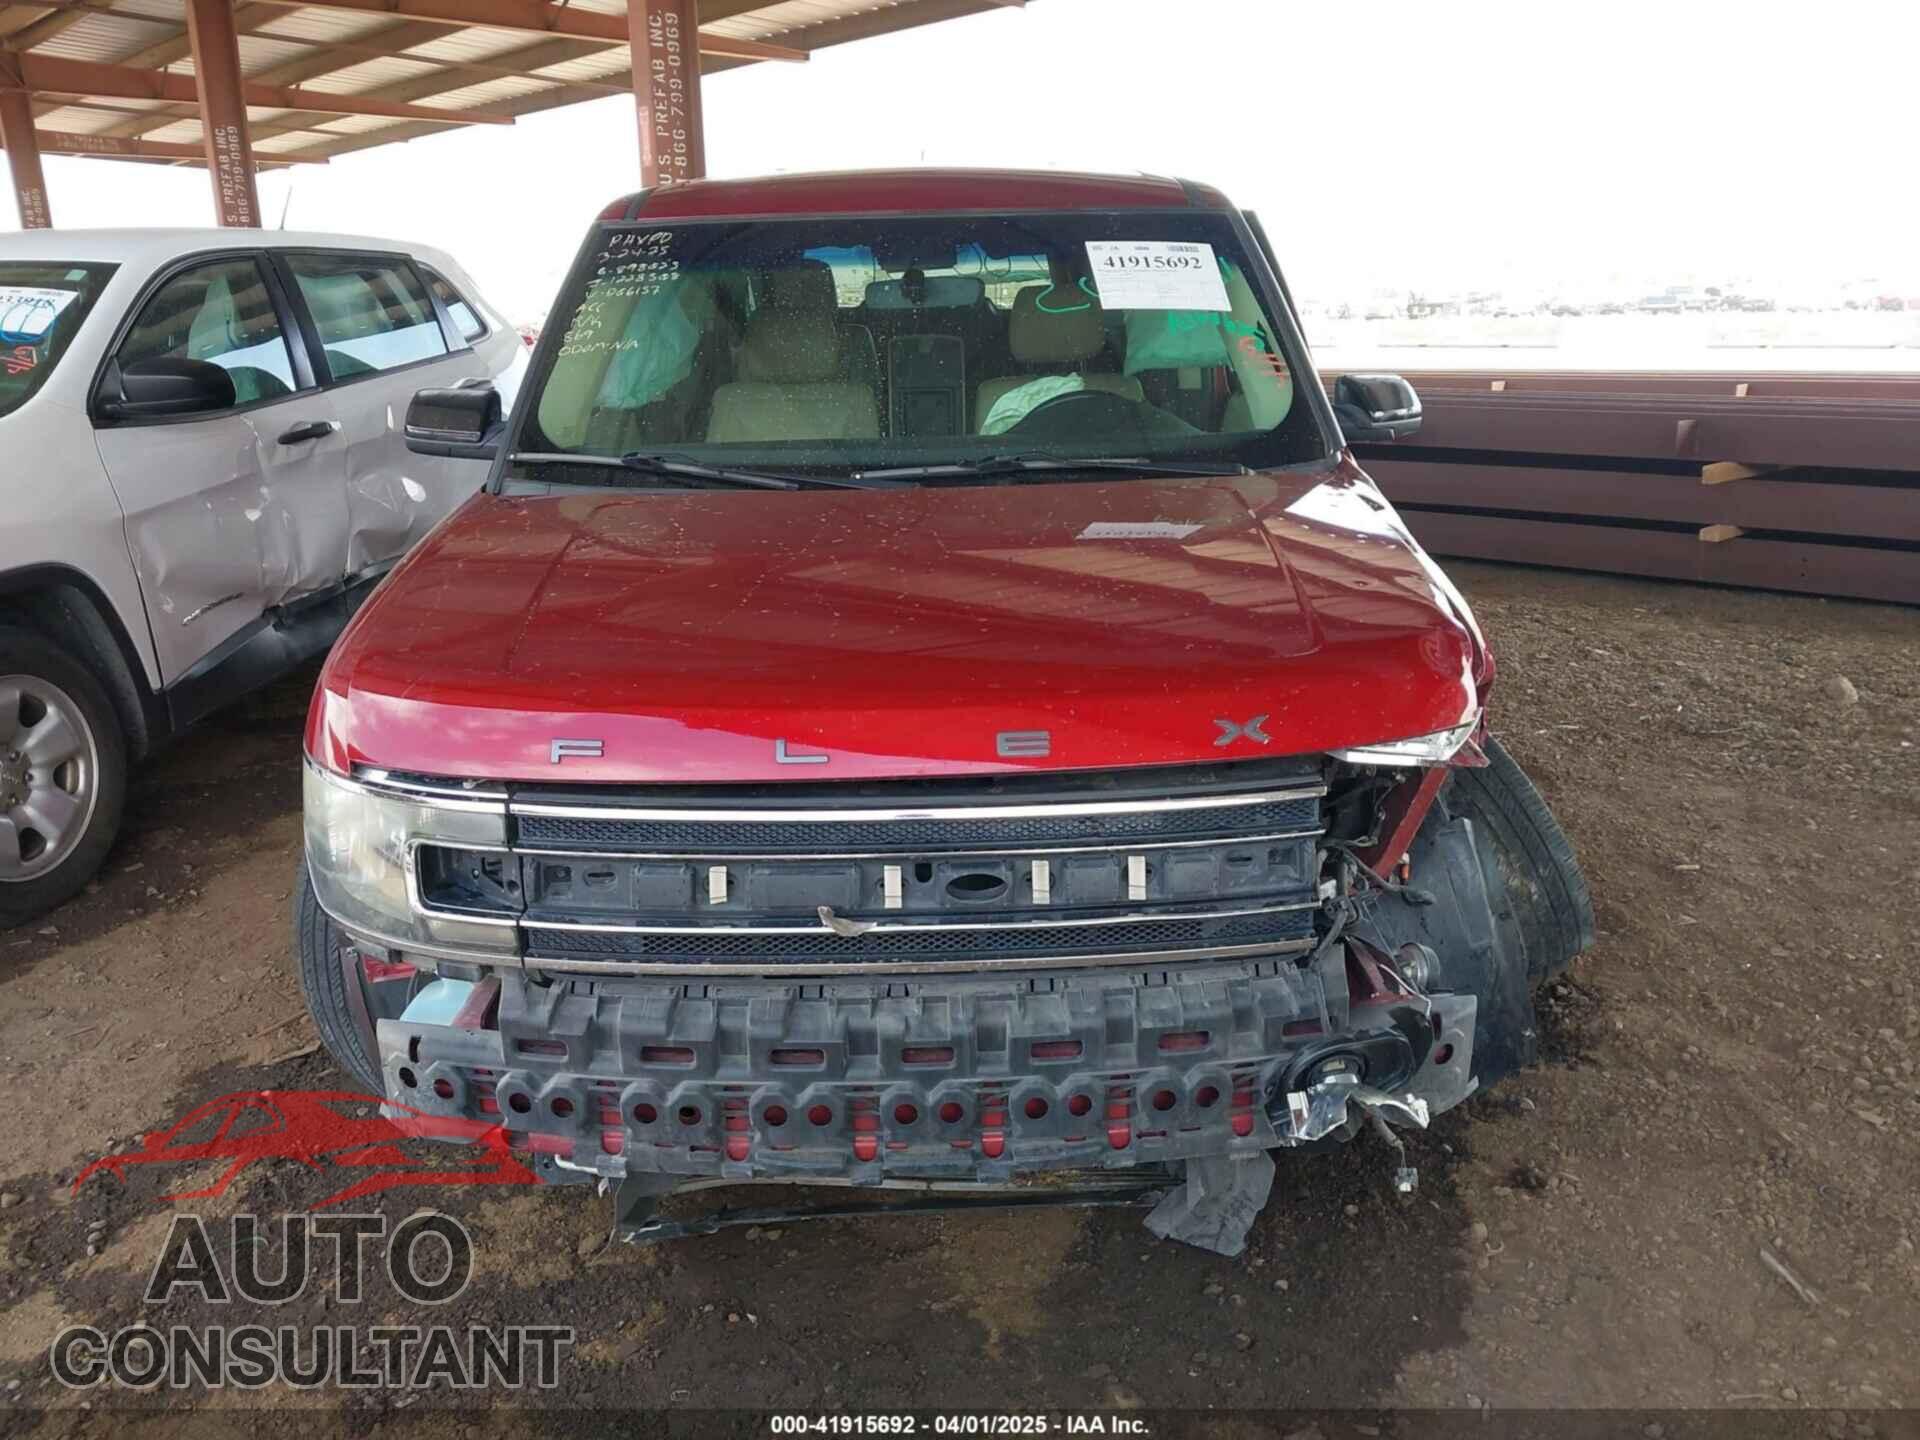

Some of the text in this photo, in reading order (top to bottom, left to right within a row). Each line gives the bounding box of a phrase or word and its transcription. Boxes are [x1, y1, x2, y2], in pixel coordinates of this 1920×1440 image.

[648, 9, 664, 48] INC.
[652, 58, 670, 137] PREFAB
[218, 154, 236, 204] PREFAB
[1104, 255, 1202, 270] 41915692
